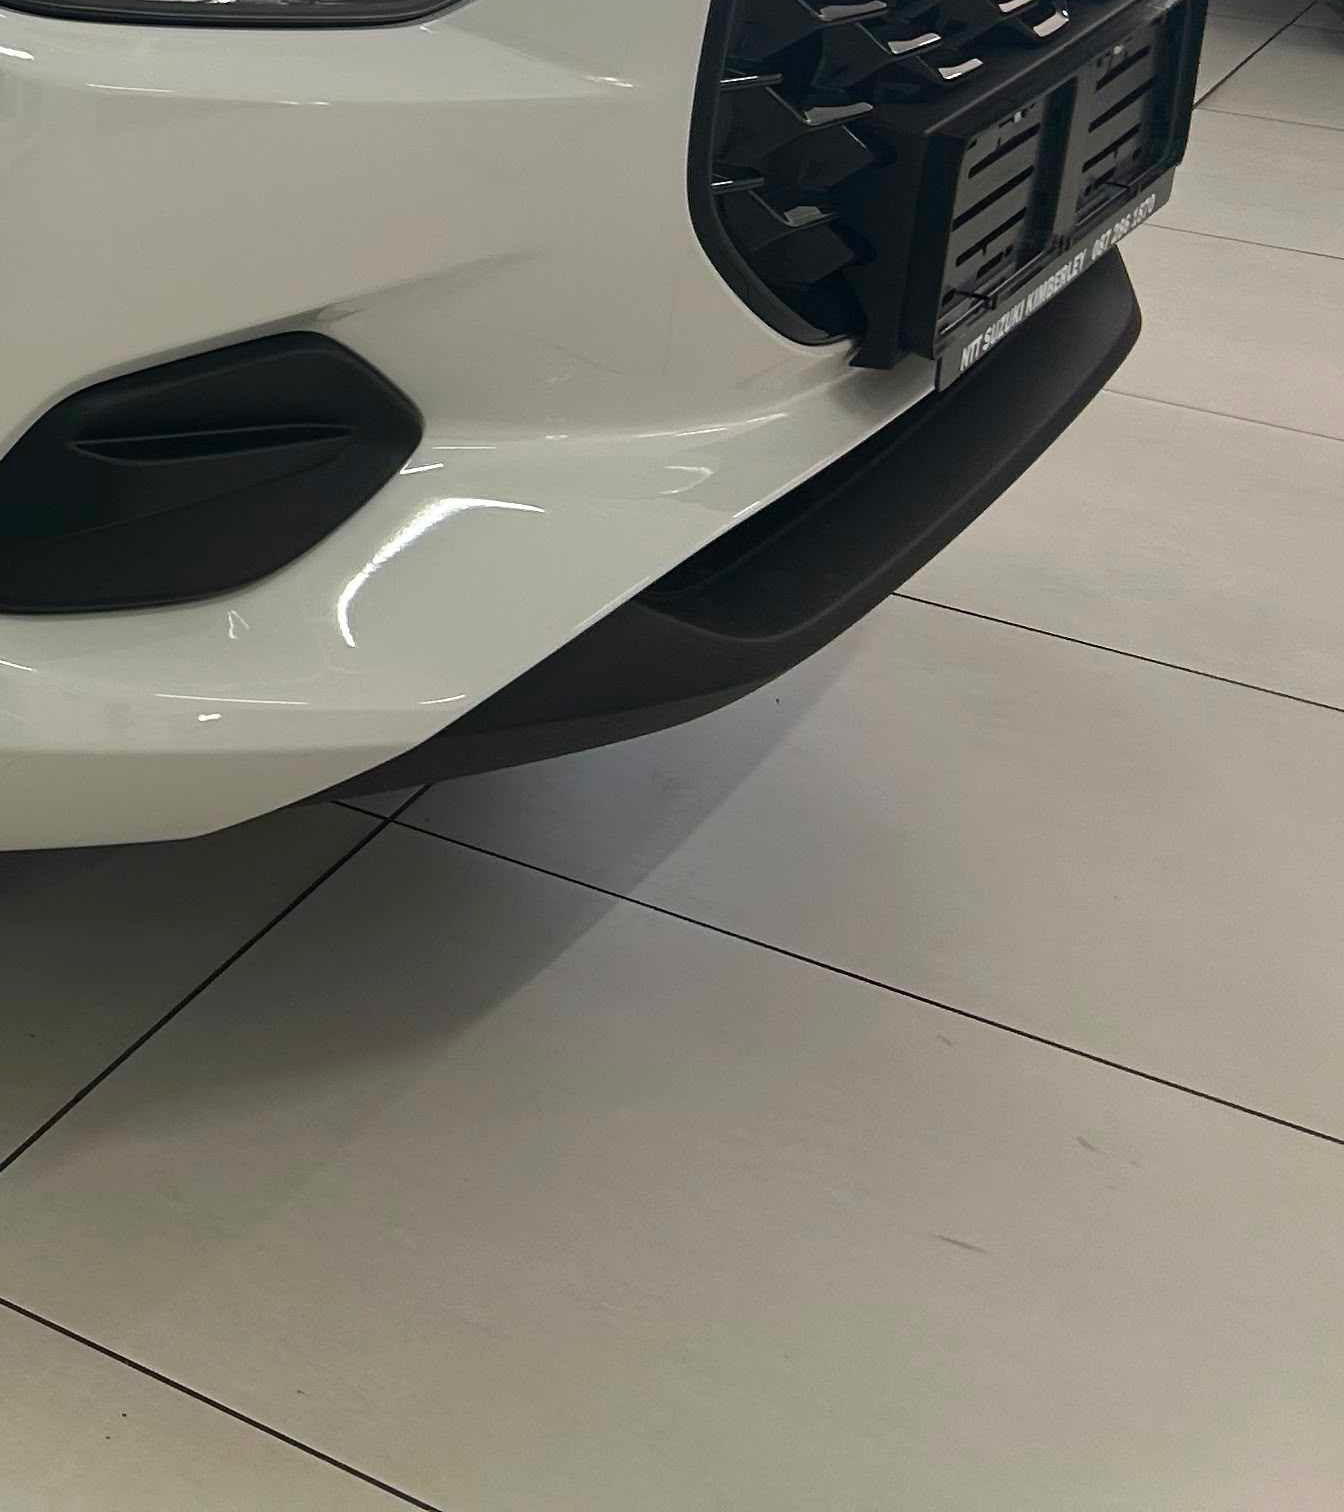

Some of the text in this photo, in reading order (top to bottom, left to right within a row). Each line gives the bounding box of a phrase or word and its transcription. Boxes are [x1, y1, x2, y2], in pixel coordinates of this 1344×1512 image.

[959, 334, 983, 371] NTT
[983, 299, 1025, 350] SUZUKI
[1024, 248, 1087, 317] KIMBERLEY
